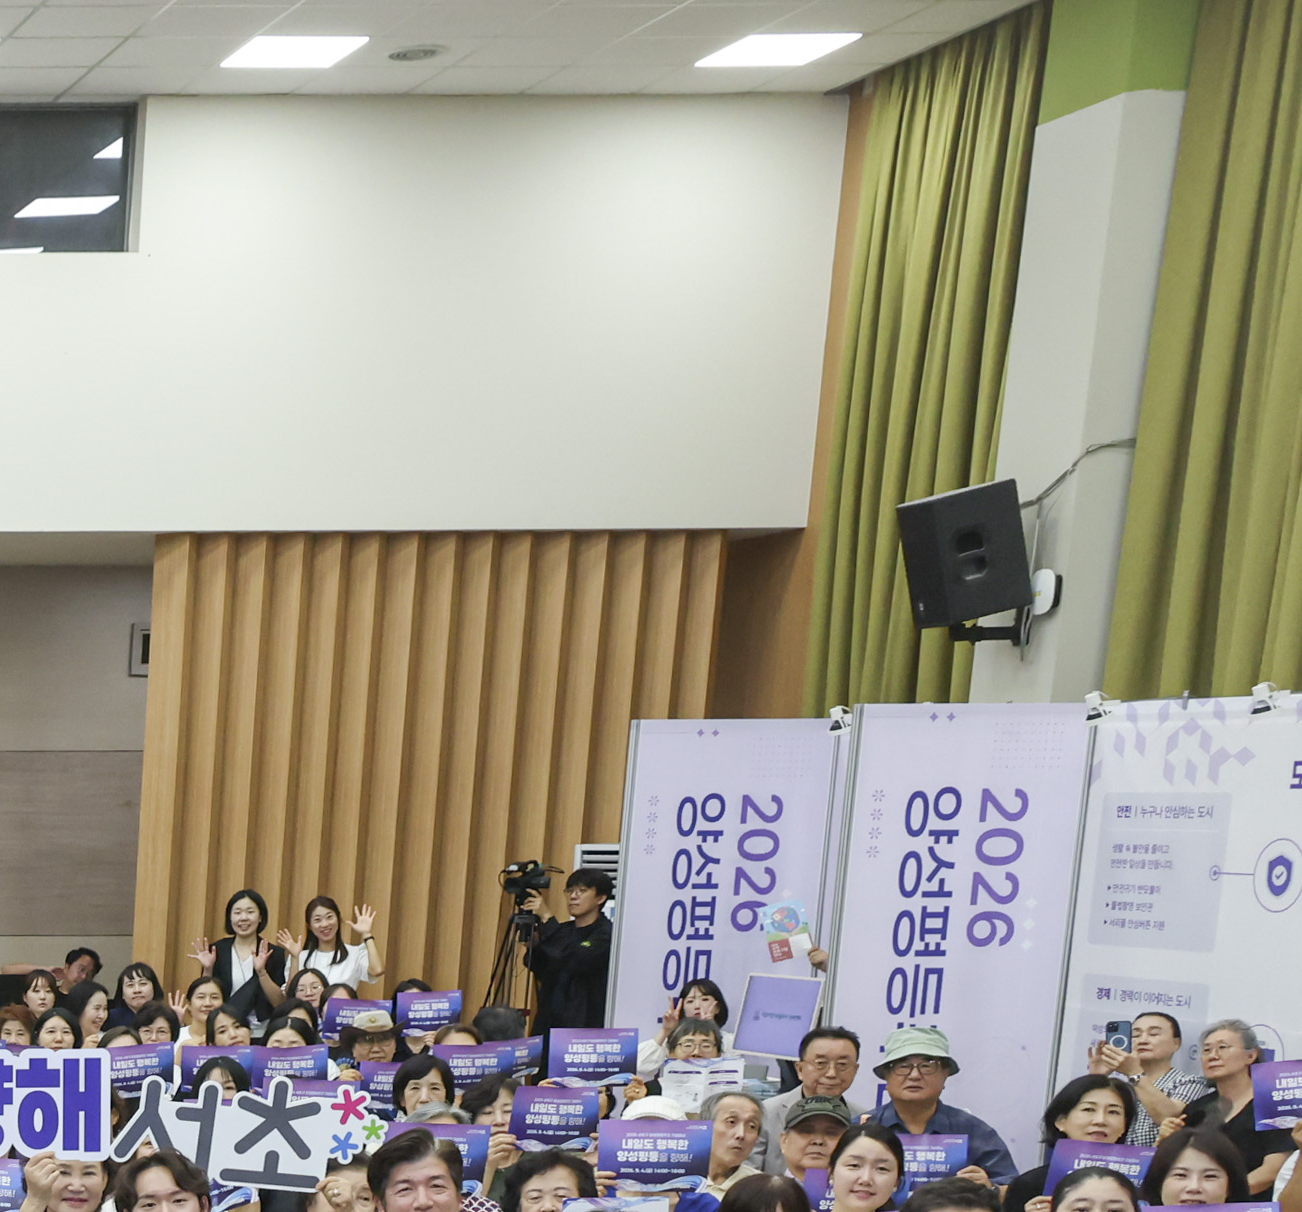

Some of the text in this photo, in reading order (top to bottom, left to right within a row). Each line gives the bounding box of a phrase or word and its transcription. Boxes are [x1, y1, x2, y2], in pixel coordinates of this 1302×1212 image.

[1116, 805, 1214, 819] 안전 누구나 안심하는 도시
[731, 794, 783, 932] 2026
[966, 787, 1029, 948] 2026
[1096, 987, 1111, 1000] 경제
[1176, 995, 1191, 1008] 도시
[120, 1077, 320, 1185] 서초
[622, 1139, 690, 1150] 내일도 행복한
[616, 1151, 669, 1162] 양성평등을
